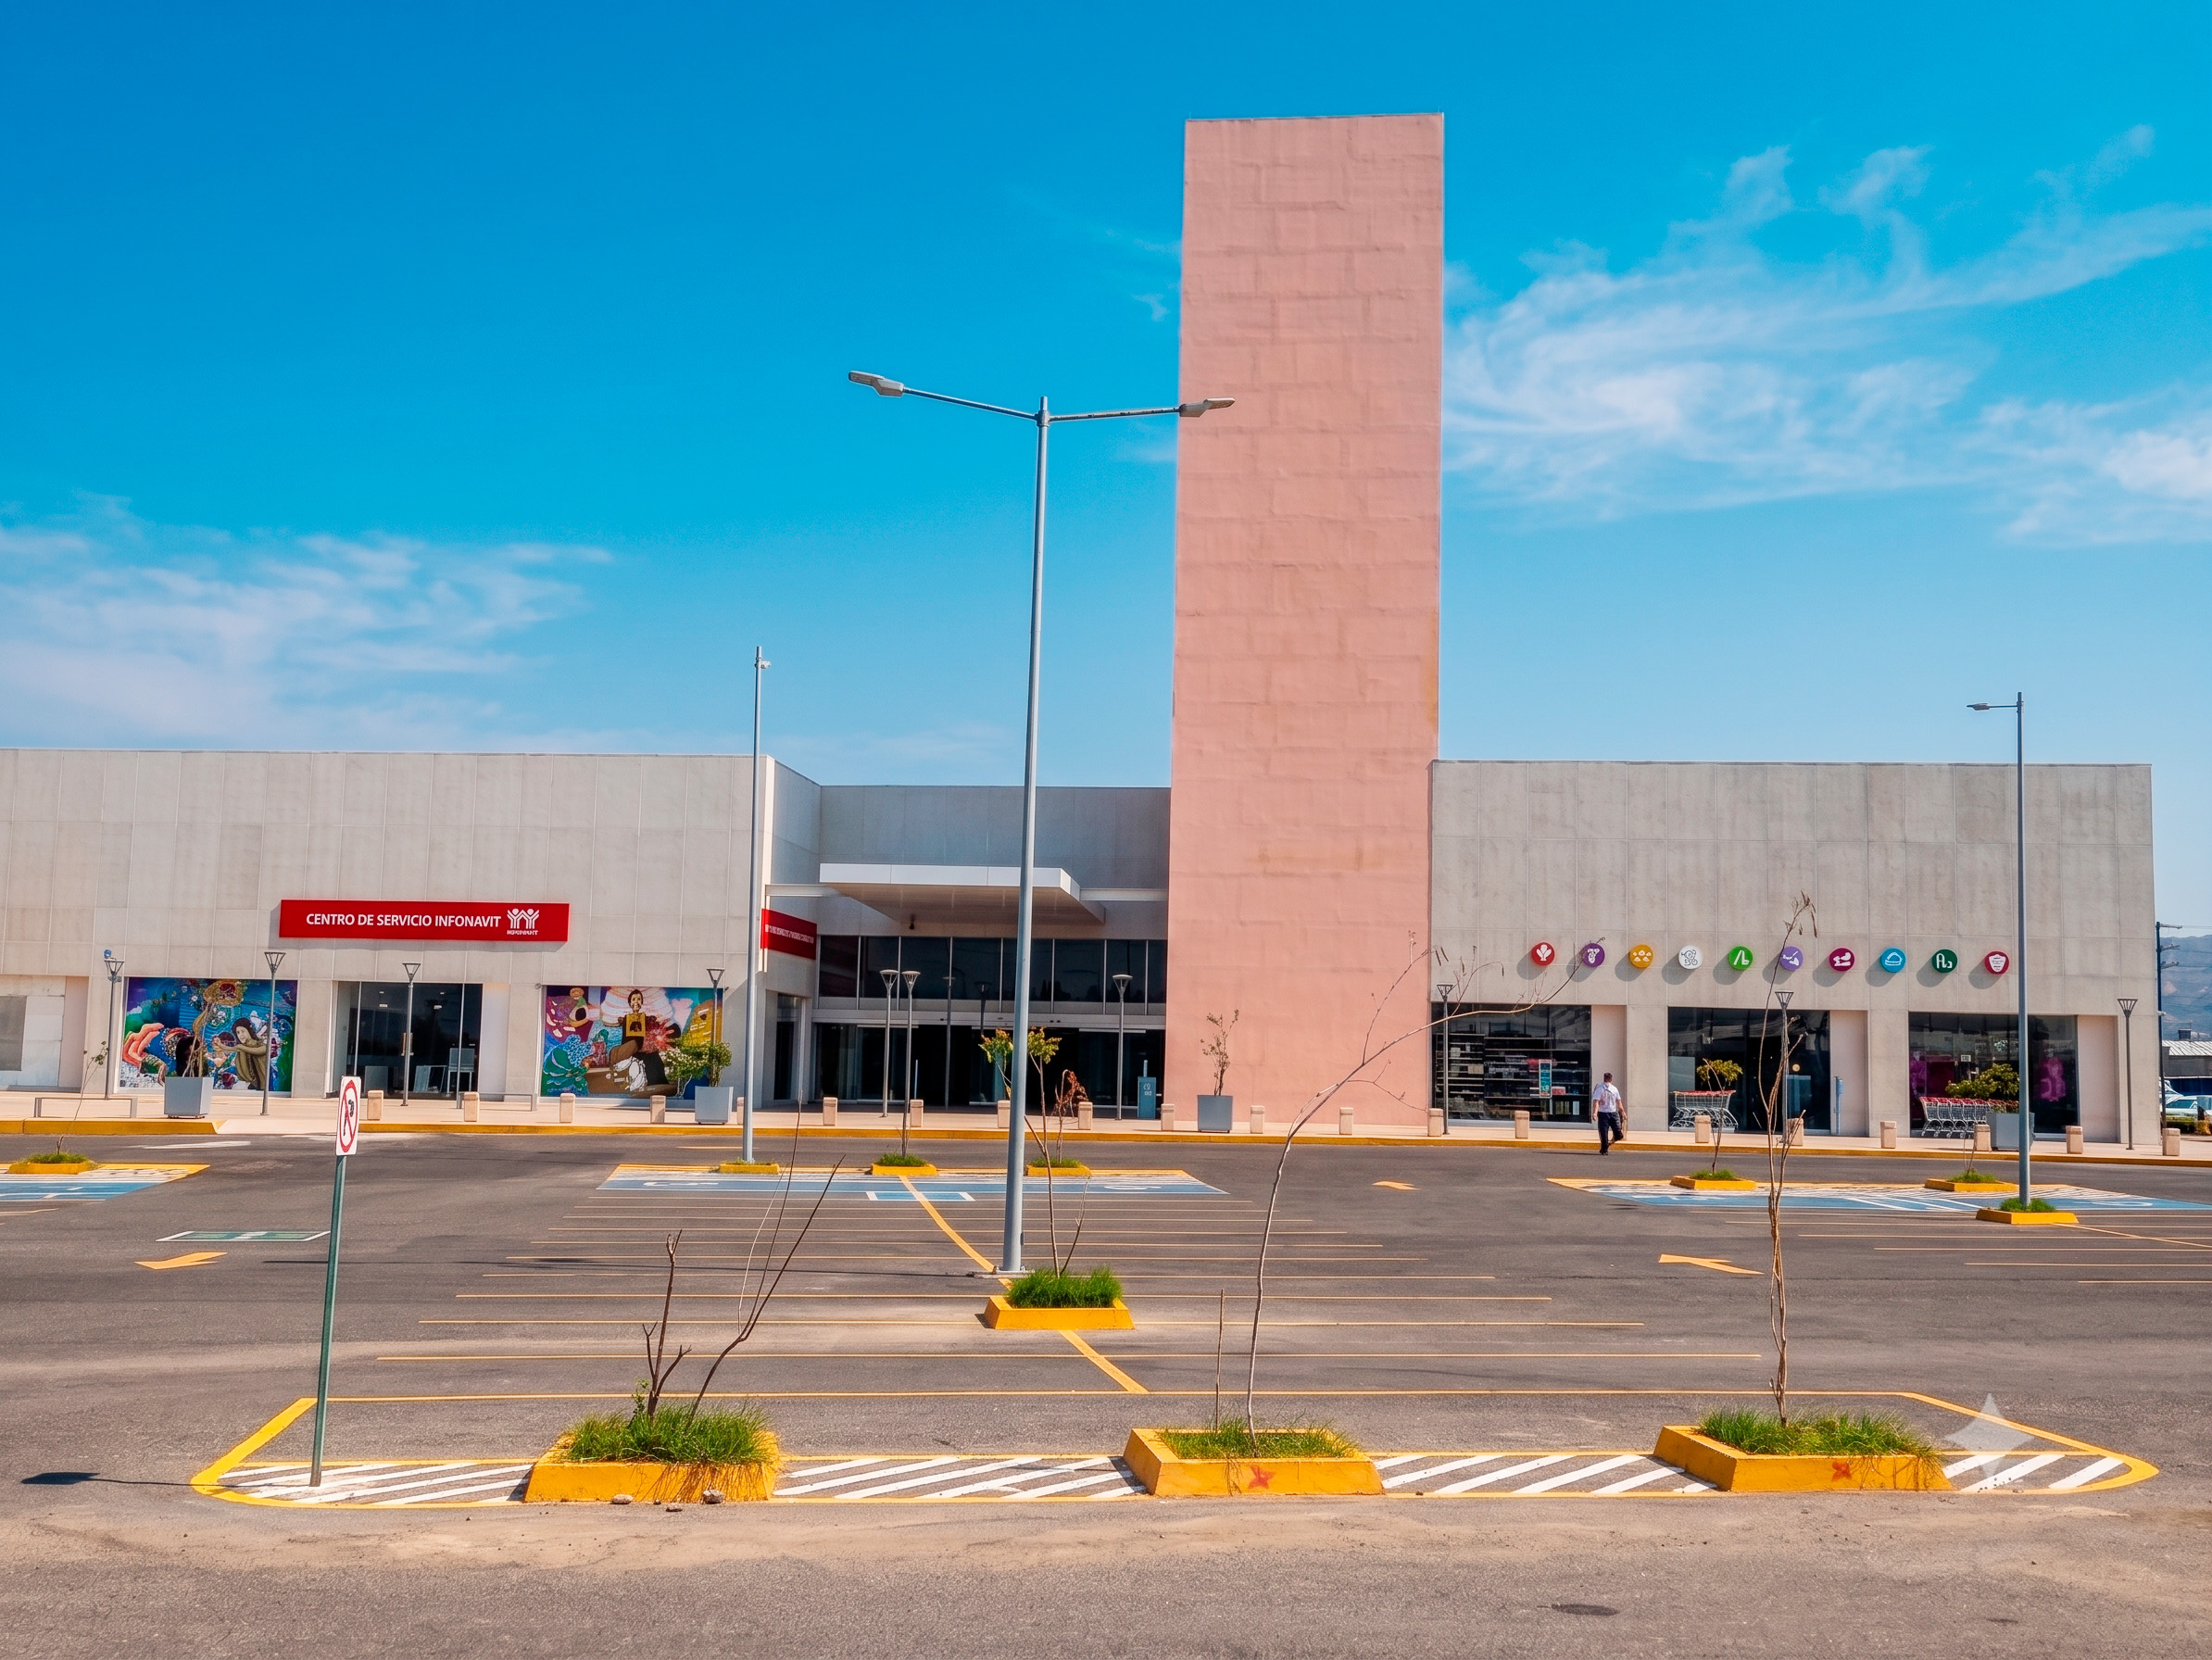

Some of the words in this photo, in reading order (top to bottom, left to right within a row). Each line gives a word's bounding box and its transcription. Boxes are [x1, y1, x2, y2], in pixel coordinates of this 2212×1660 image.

[306, 912, 356, 925] CENTRO
[358, 913, 374, 926] DE
[376, 913, 433, 927] SERVICIO
[434, 914, 501, 928] INFONAVIT
